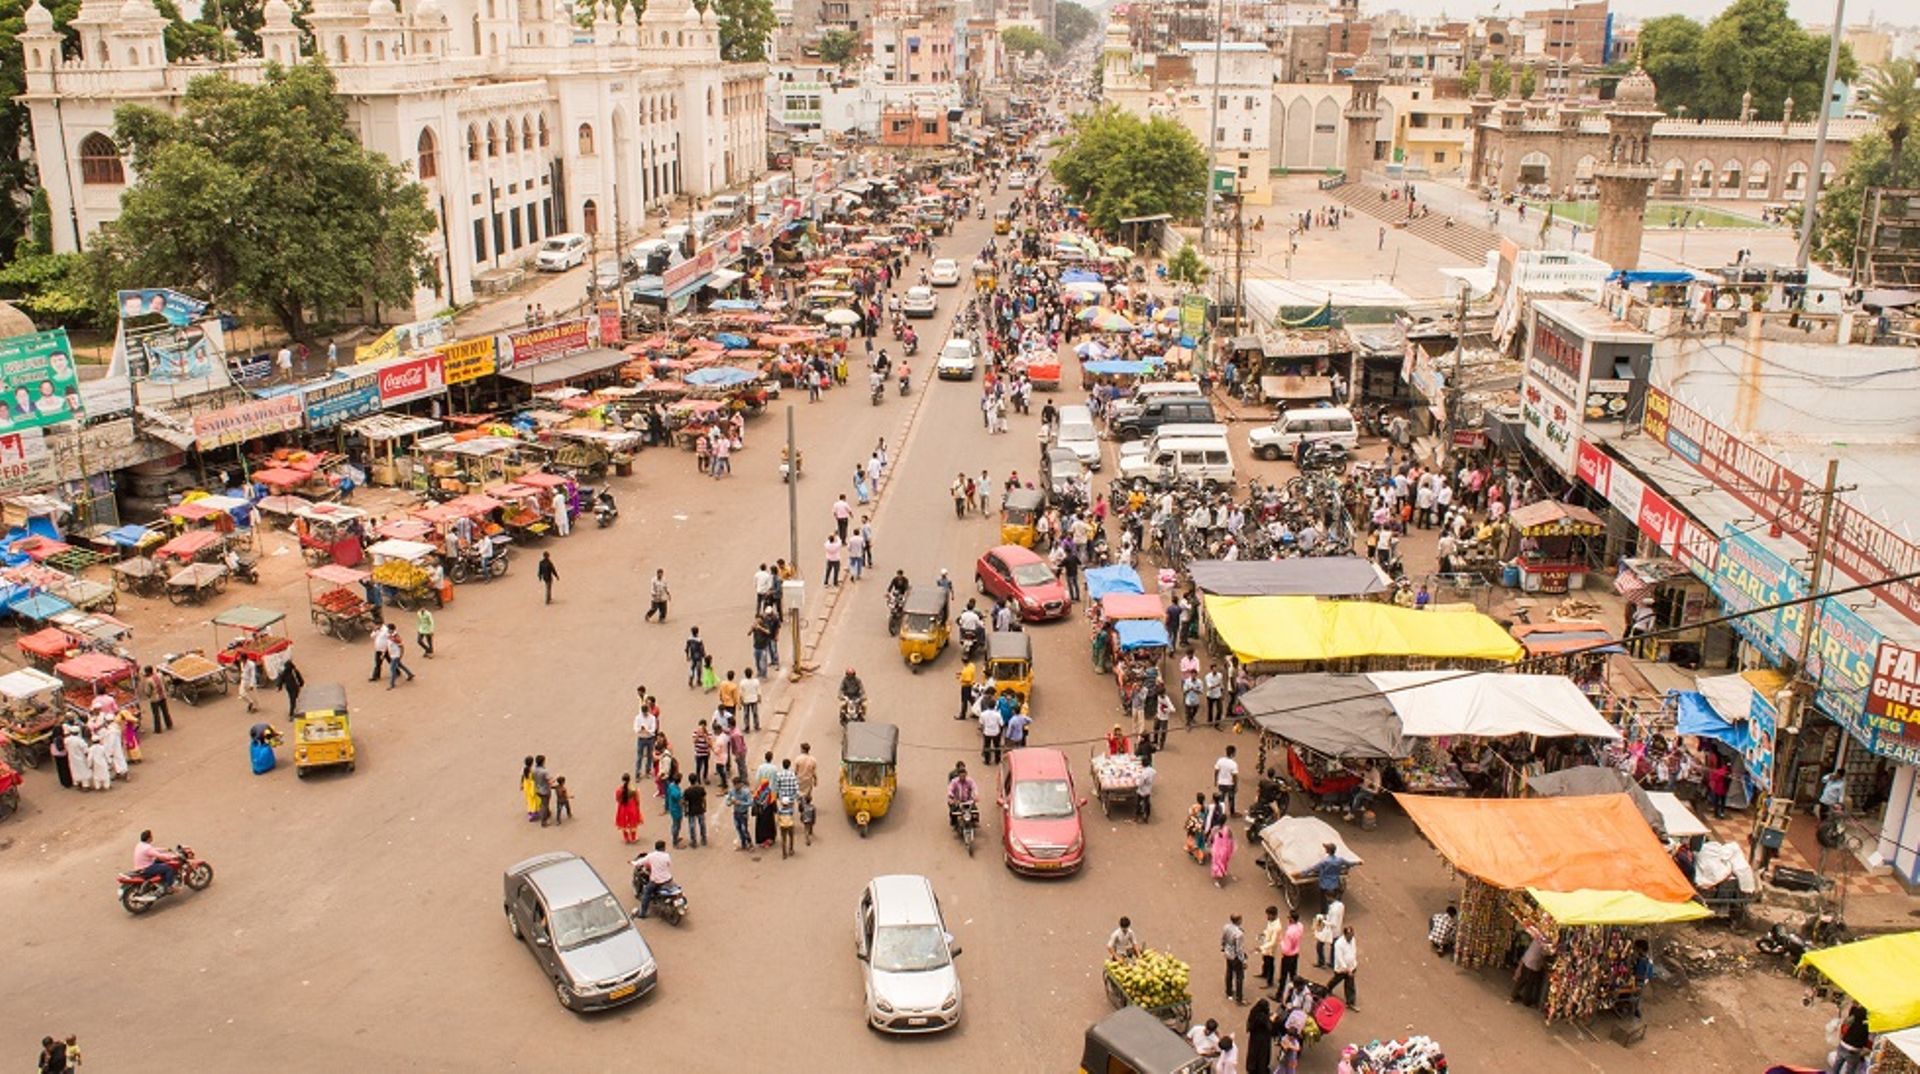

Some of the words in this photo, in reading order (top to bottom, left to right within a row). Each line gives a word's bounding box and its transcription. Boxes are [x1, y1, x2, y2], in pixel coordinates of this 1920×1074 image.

[1720, 553, 1780, 612] PEARLS
[1878, 645, 1920, 686] FA
[1874, 678, 1920, 707] CAFE
[1868, 714, 1901, 733] VEG
[1886, 702, 1920, 723] IRA
